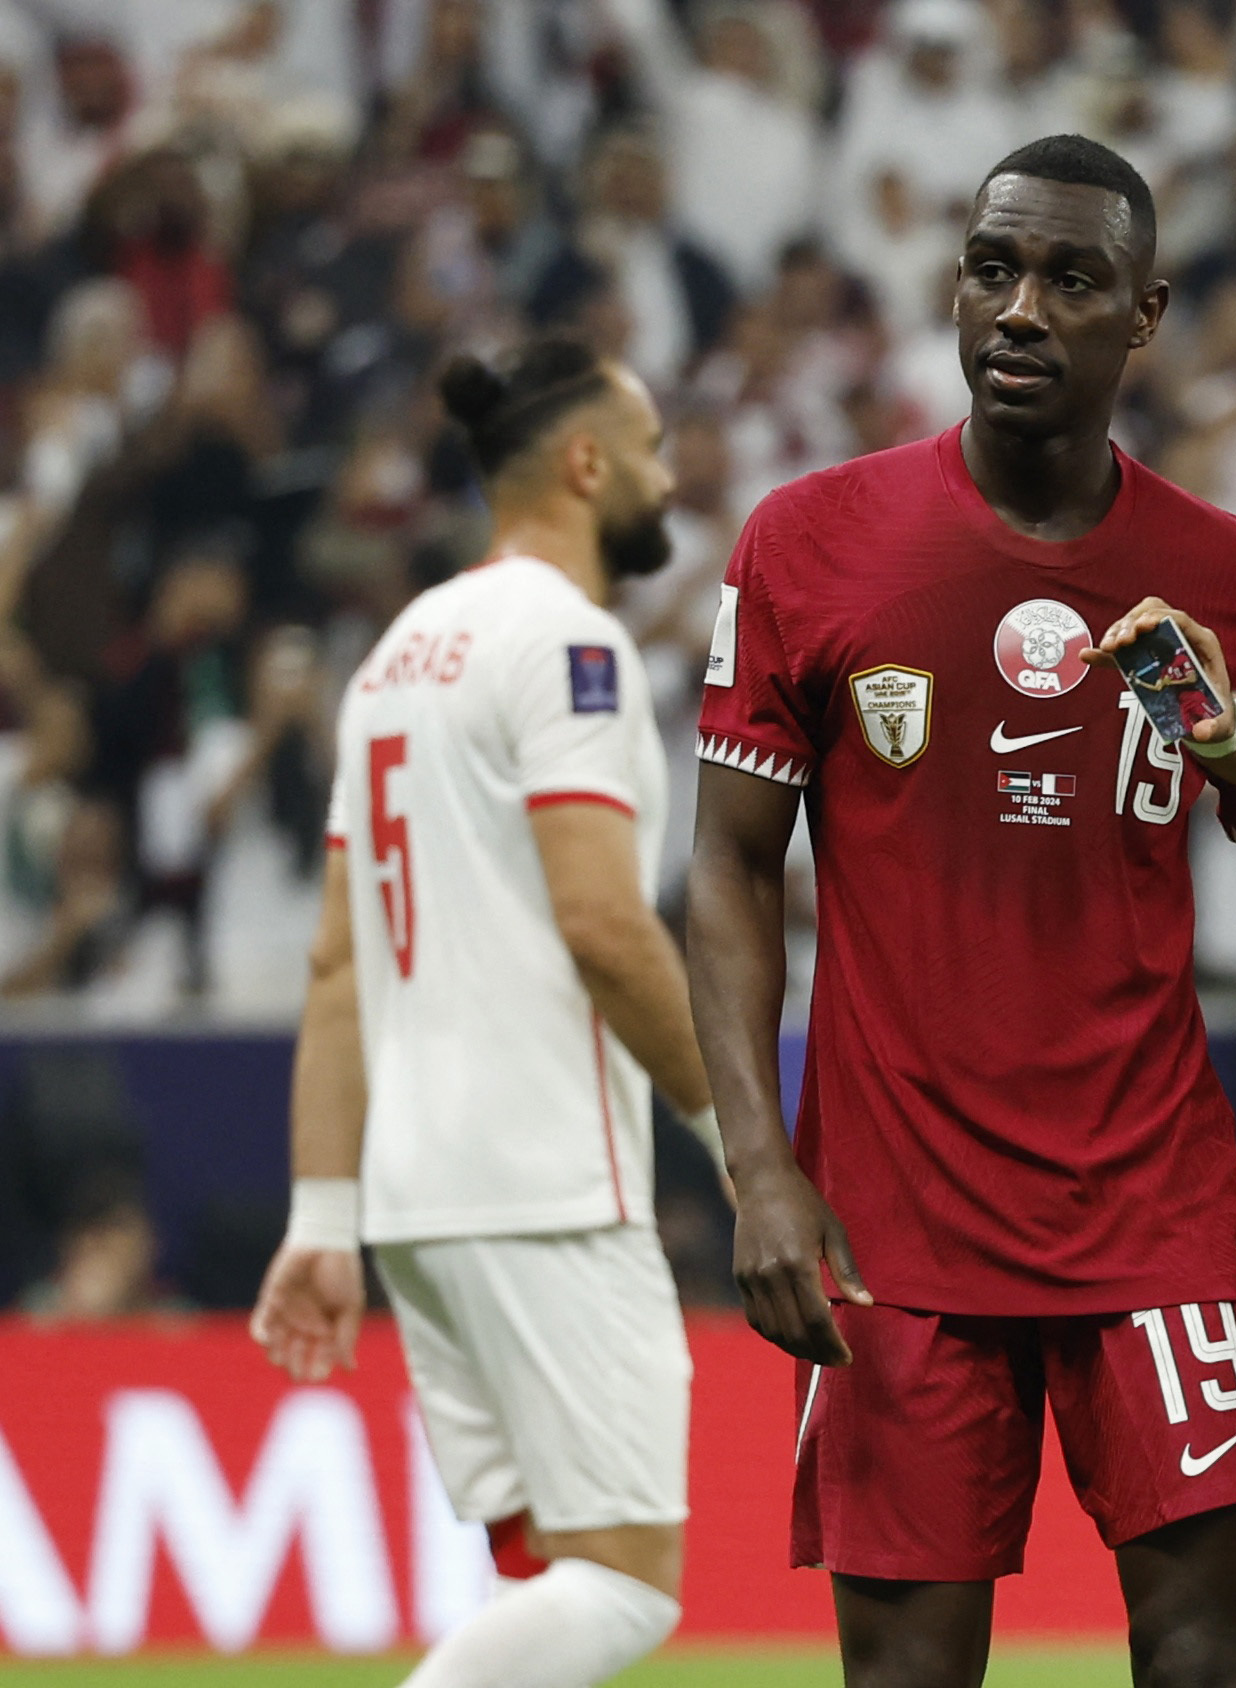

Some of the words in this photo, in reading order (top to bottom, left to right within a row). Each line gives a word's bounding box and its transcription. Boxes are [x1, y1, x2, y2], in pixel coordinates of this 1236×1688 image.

[866, 683, 894, 691] ASIAN
[896, 682, 916, 690] CUP
[867, 701, 917, 709] CHAMPIONS
[1011, 795, 1021, 803] 10
[1023, 795, 1038, 804] FEB
[1040, 797, 1060, 806] 2024
[1022, 805, 1049, 815] FINAL
[1000, 814, 1030, 823] LUSAIL
[1032, 815, 1070, 826] STADIUM
[369, 733, 413, 980] 5
